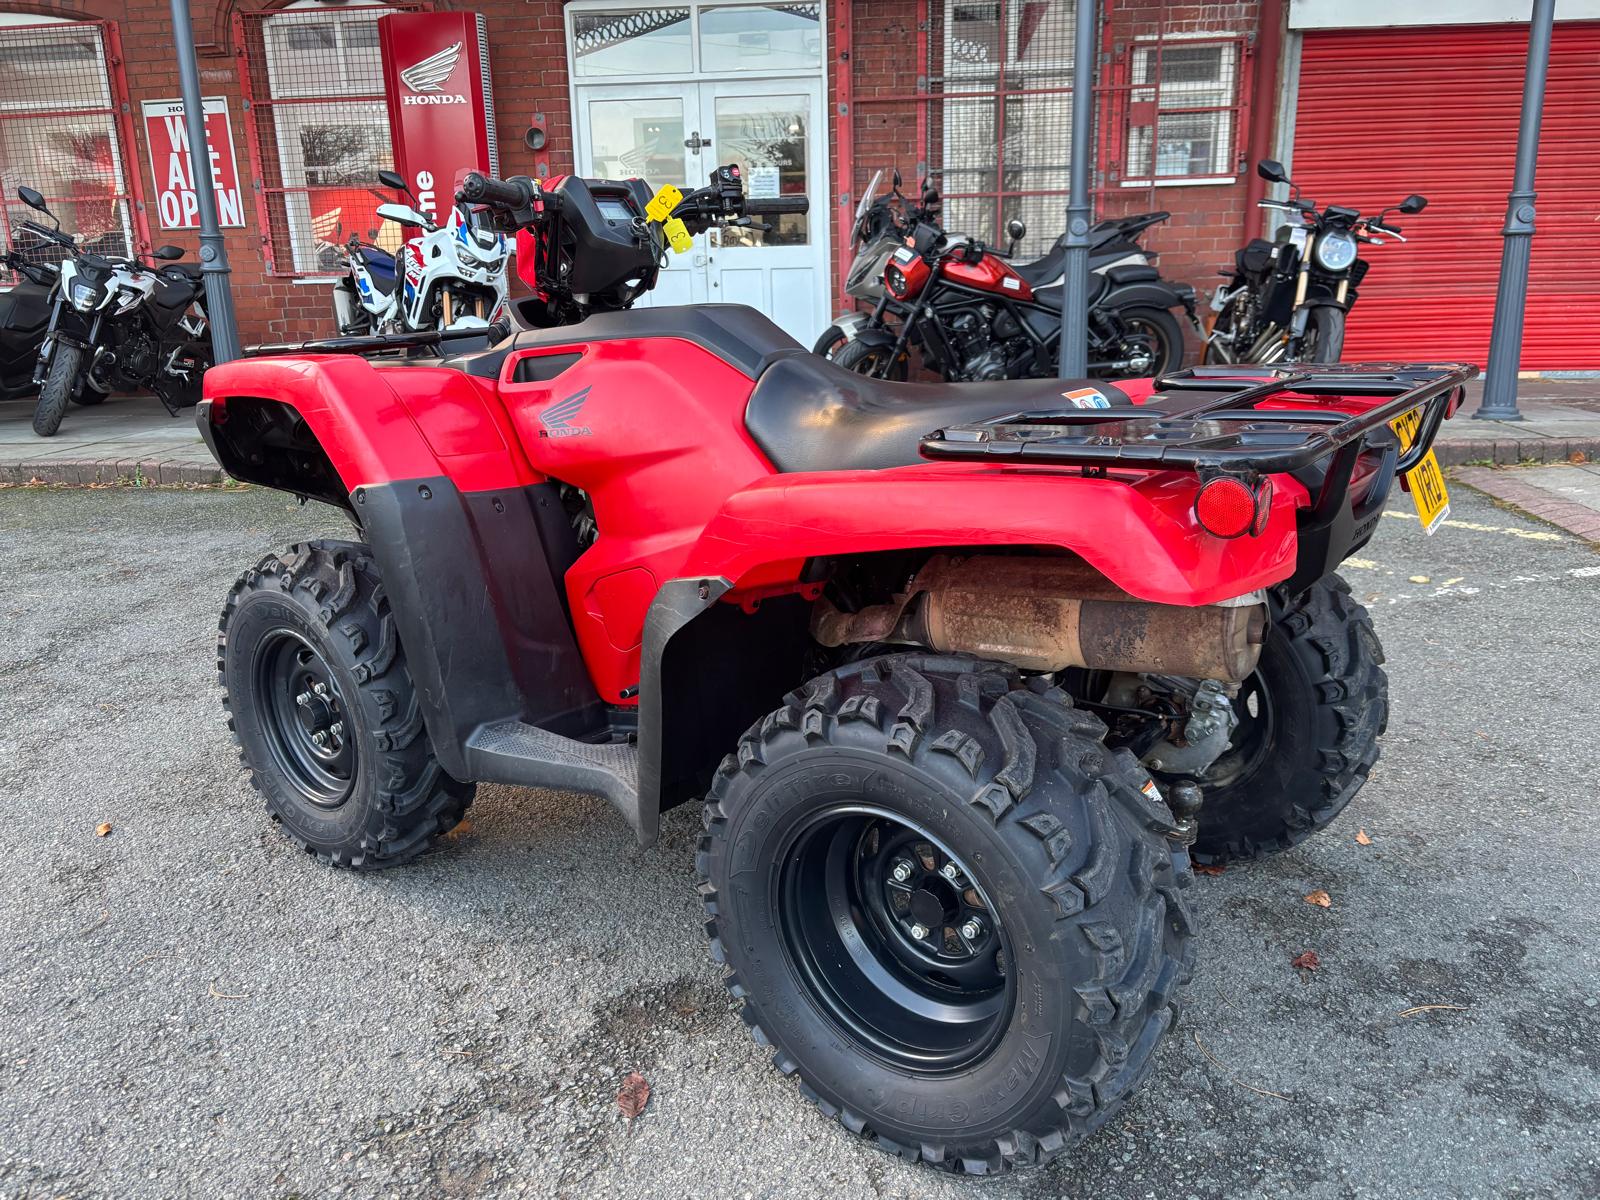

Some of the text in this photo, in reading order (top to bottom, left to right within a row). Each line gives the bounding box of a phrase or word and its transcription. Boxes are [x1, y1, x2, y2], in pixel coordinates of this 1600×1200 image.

[403, 94, 467, 105] HONDA
[619, 168, 660, 176] HONDA
[160, 189, 240, 228] OPN
[538, 426, 593, 438] HONDA
